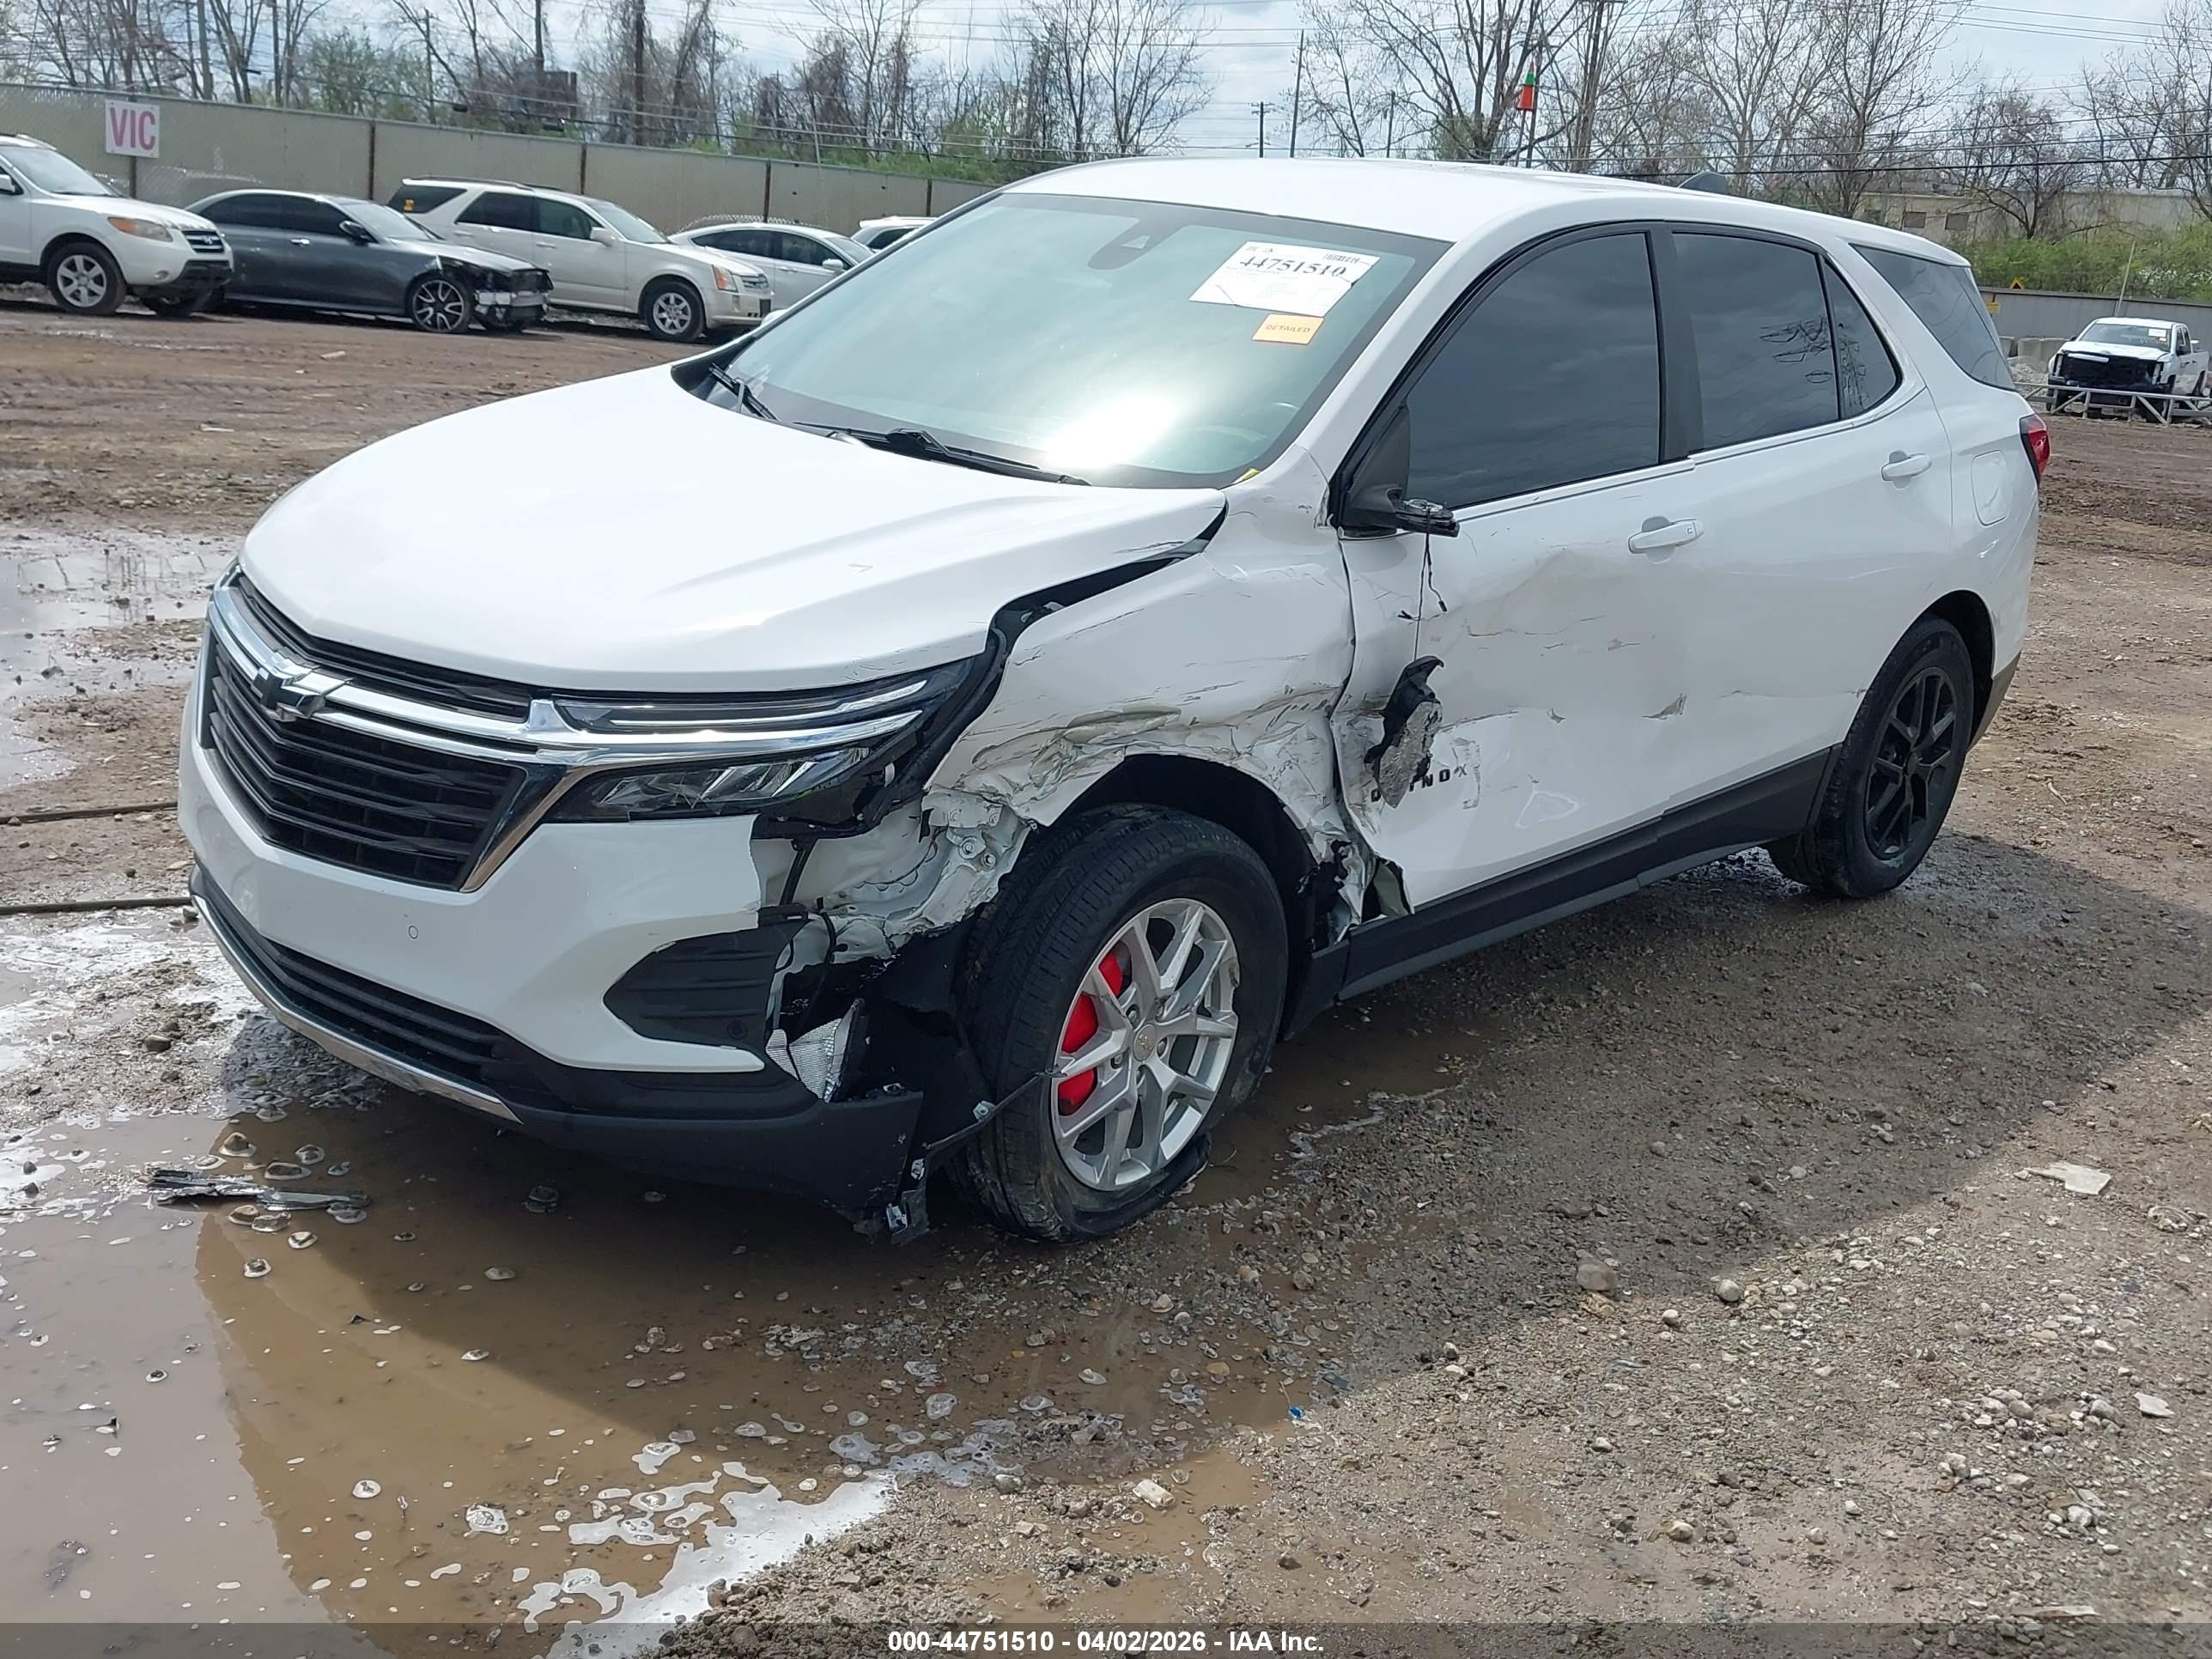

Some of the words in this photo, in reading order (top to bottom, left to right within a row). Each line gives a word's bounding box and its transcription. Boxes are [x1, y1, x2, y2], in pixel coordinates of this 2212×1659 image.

[110, 106, 155, 150] VIC
[1239, 256, 1346, 276] 44751510
[1265, 325, 1310, 333] DETAILED
